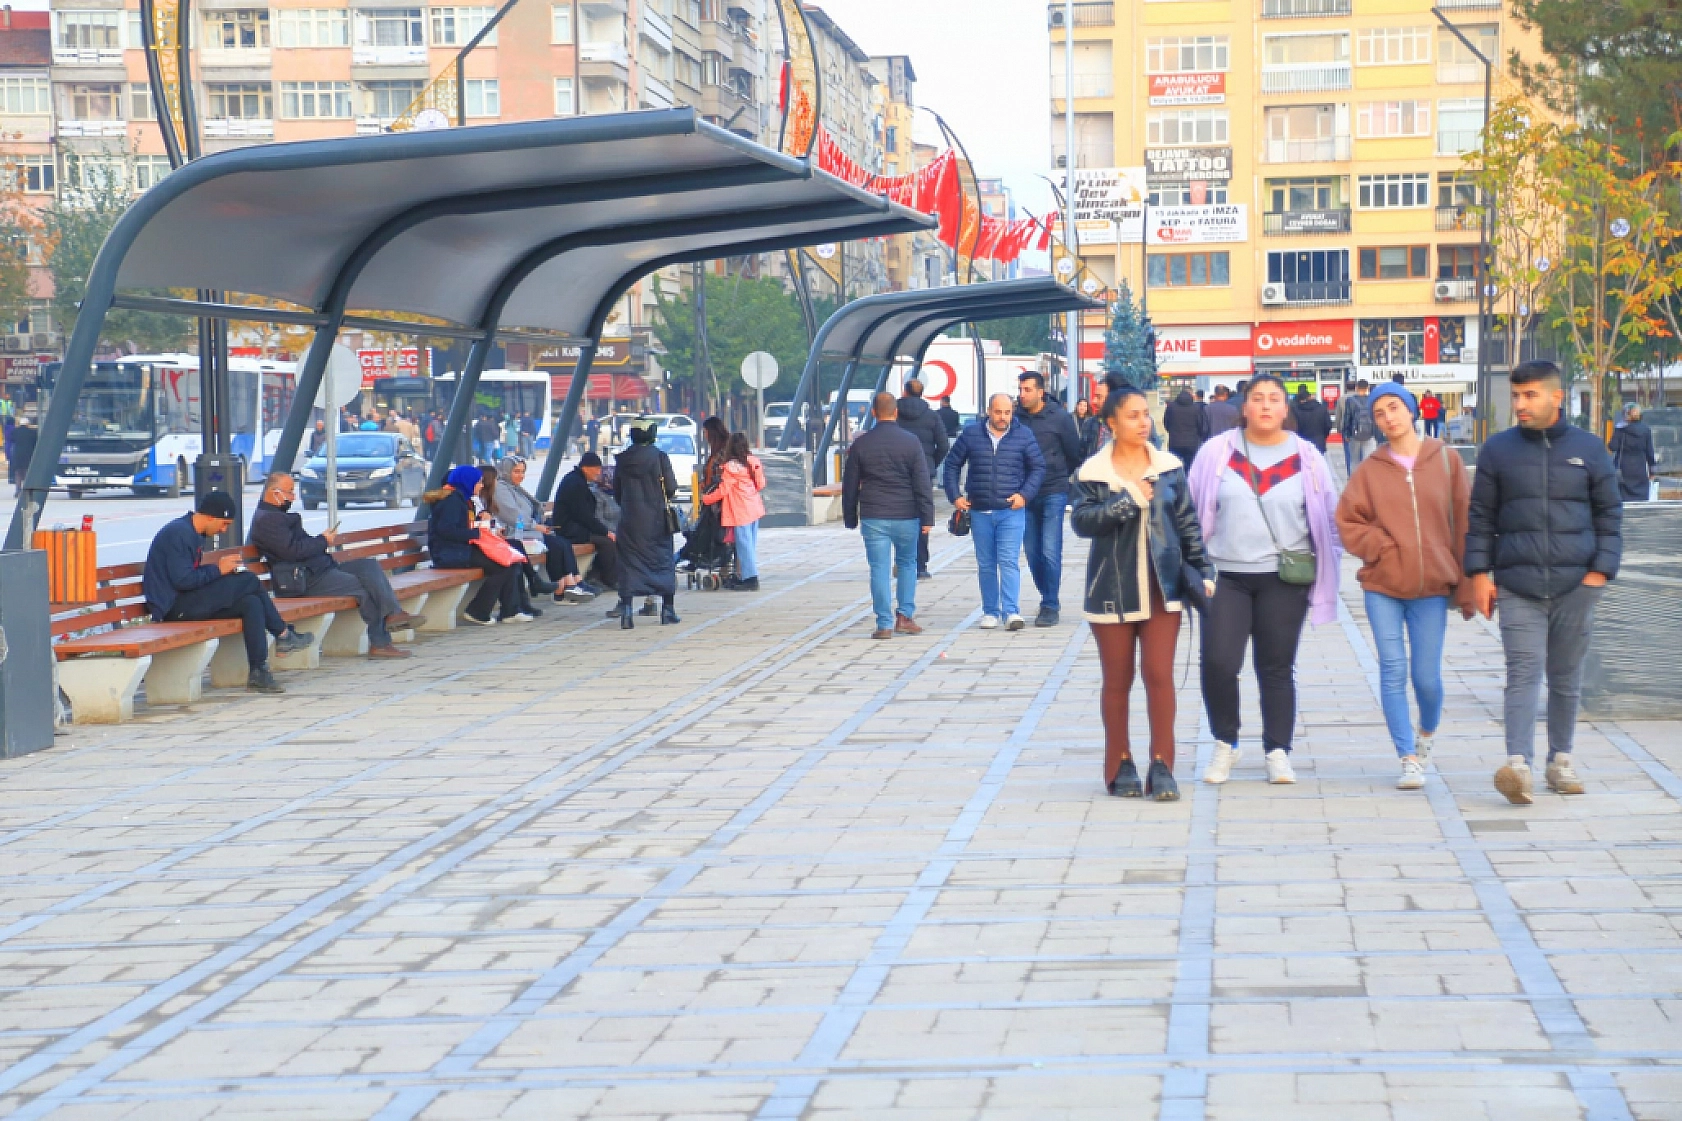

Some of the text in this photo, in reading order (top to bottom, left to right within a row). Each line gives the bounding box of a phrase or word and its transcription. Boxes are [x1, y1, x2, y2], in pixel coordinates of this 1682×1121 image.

[1151, 157, 1227, 172] TATTOO
[1198, 217, 1237, 226] FATURA
[1276, 333, 1333, 346] vodafone
